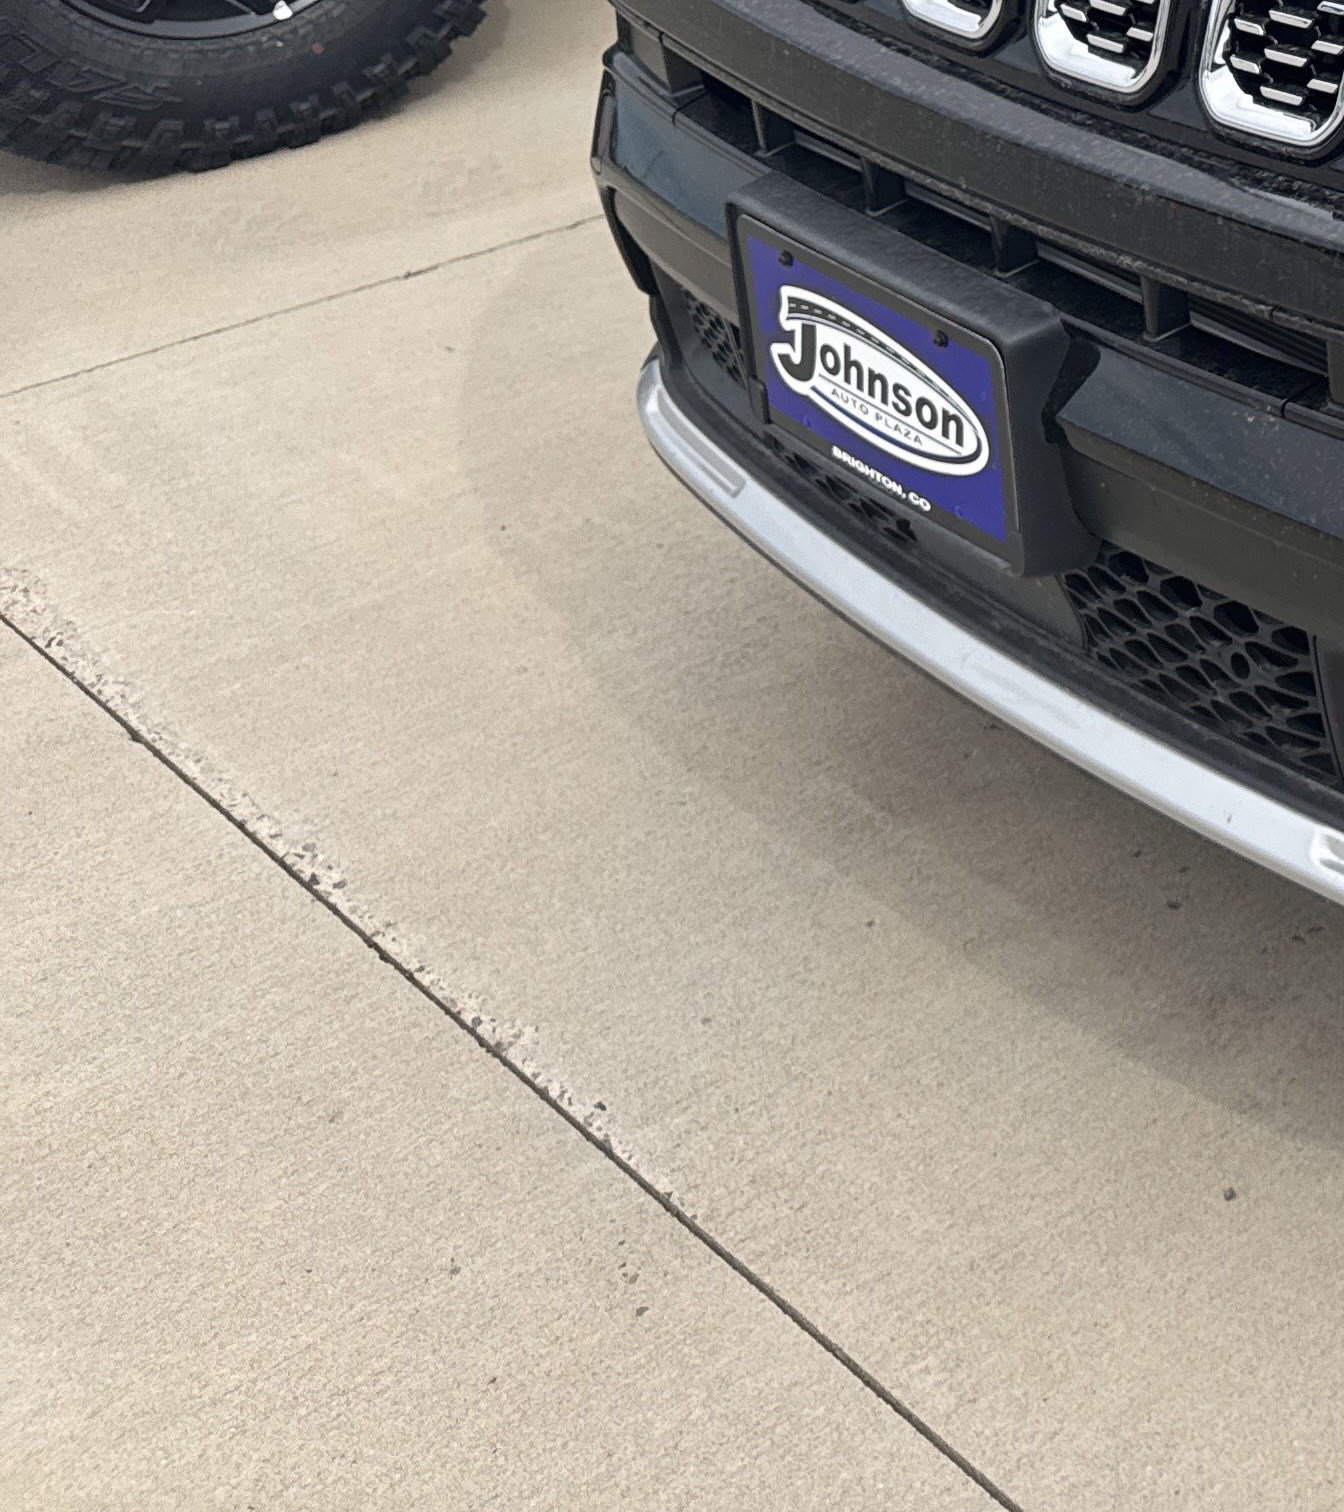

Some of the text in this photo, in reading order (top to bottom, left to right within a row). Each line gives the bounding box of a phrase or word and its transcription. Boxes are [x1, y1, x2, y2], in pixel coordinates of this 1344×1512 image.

[778, 323, 965, 448] Johnson
[831, 388, 923, 446] AUTO PLAZA
[908, 492, 931, 512] CO
